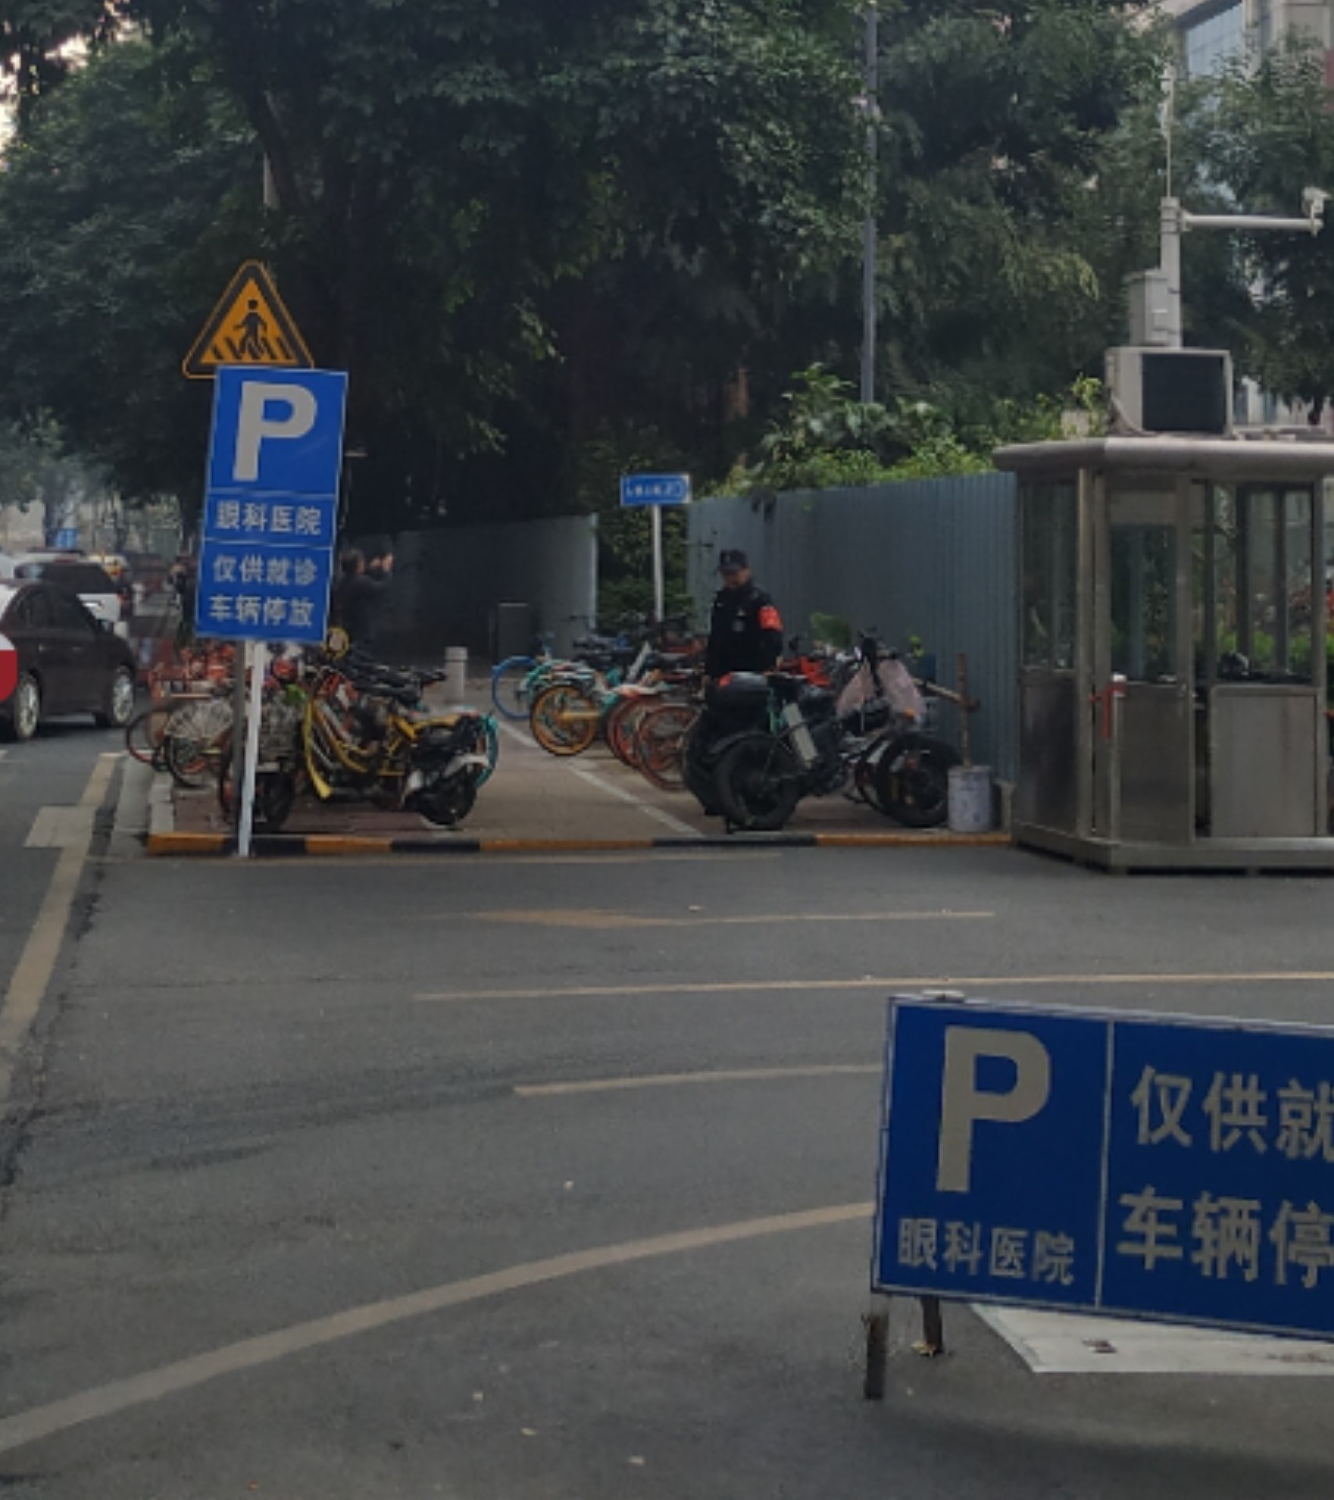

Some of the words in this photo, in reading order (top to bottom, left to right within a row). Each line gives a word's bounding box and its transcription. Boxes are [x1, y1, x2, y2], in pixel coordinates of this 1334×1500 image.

[233, 380, 318, 482] P
[214, 500, 322, 536] 眼科医院
[212, 555, 319, 589] 仅供就诊
[208, 594, 315, 630] 车辆停放
[936, 1025, 1052, 1193] P
[897, 1217, 1077, 1286] 眼科医院
